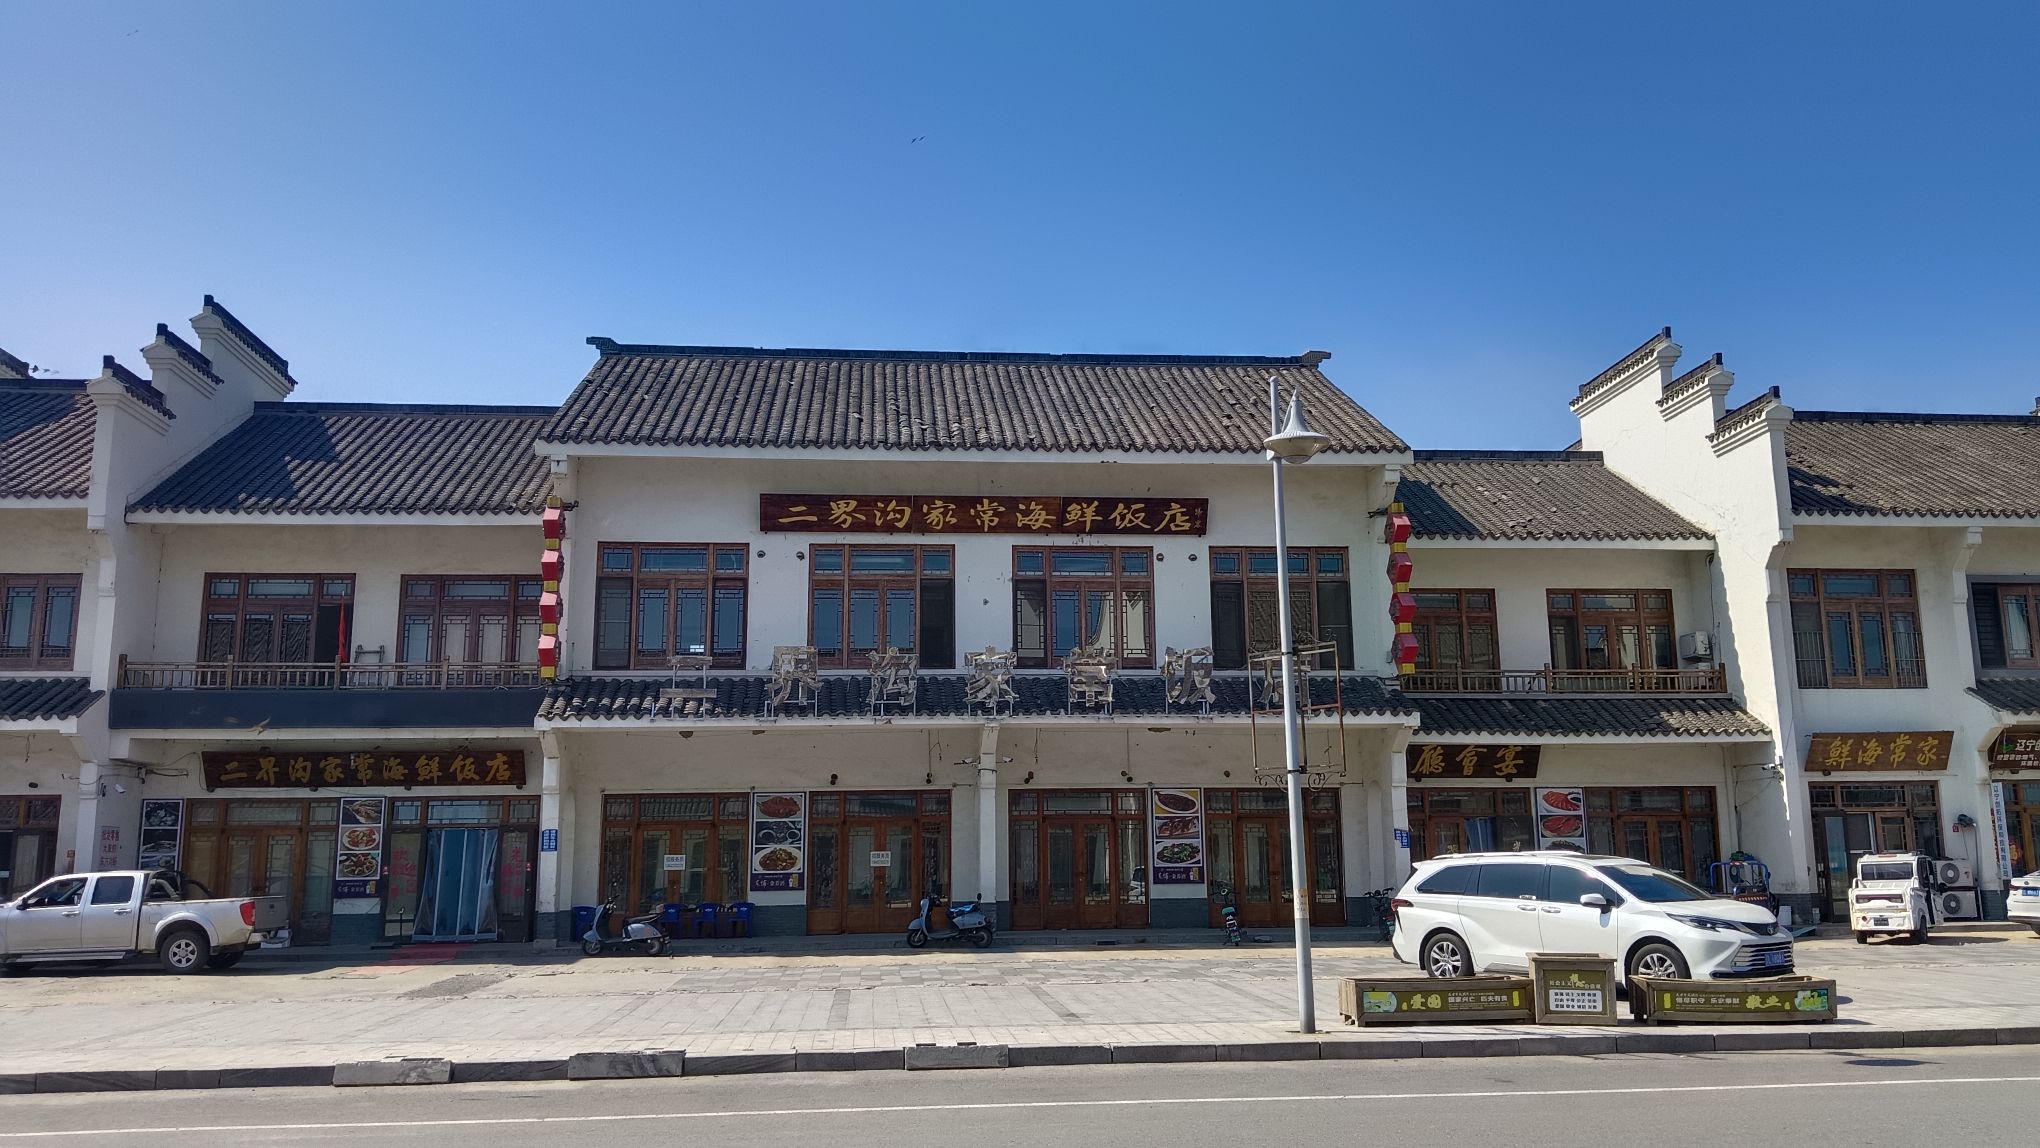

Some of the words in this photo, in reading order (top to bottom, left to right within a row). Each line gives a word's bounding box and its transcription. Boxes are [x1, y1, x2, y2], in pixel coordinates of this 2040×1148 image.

[778, 498, 1191, 533] 二界沟家常海鲜饭店
[220, 752, 513, 785] 二界沟家常海鲜饭店
[1410, 993, 1442, 1010] 爱国
[1745, 993, 1782, 1010] 敬业
